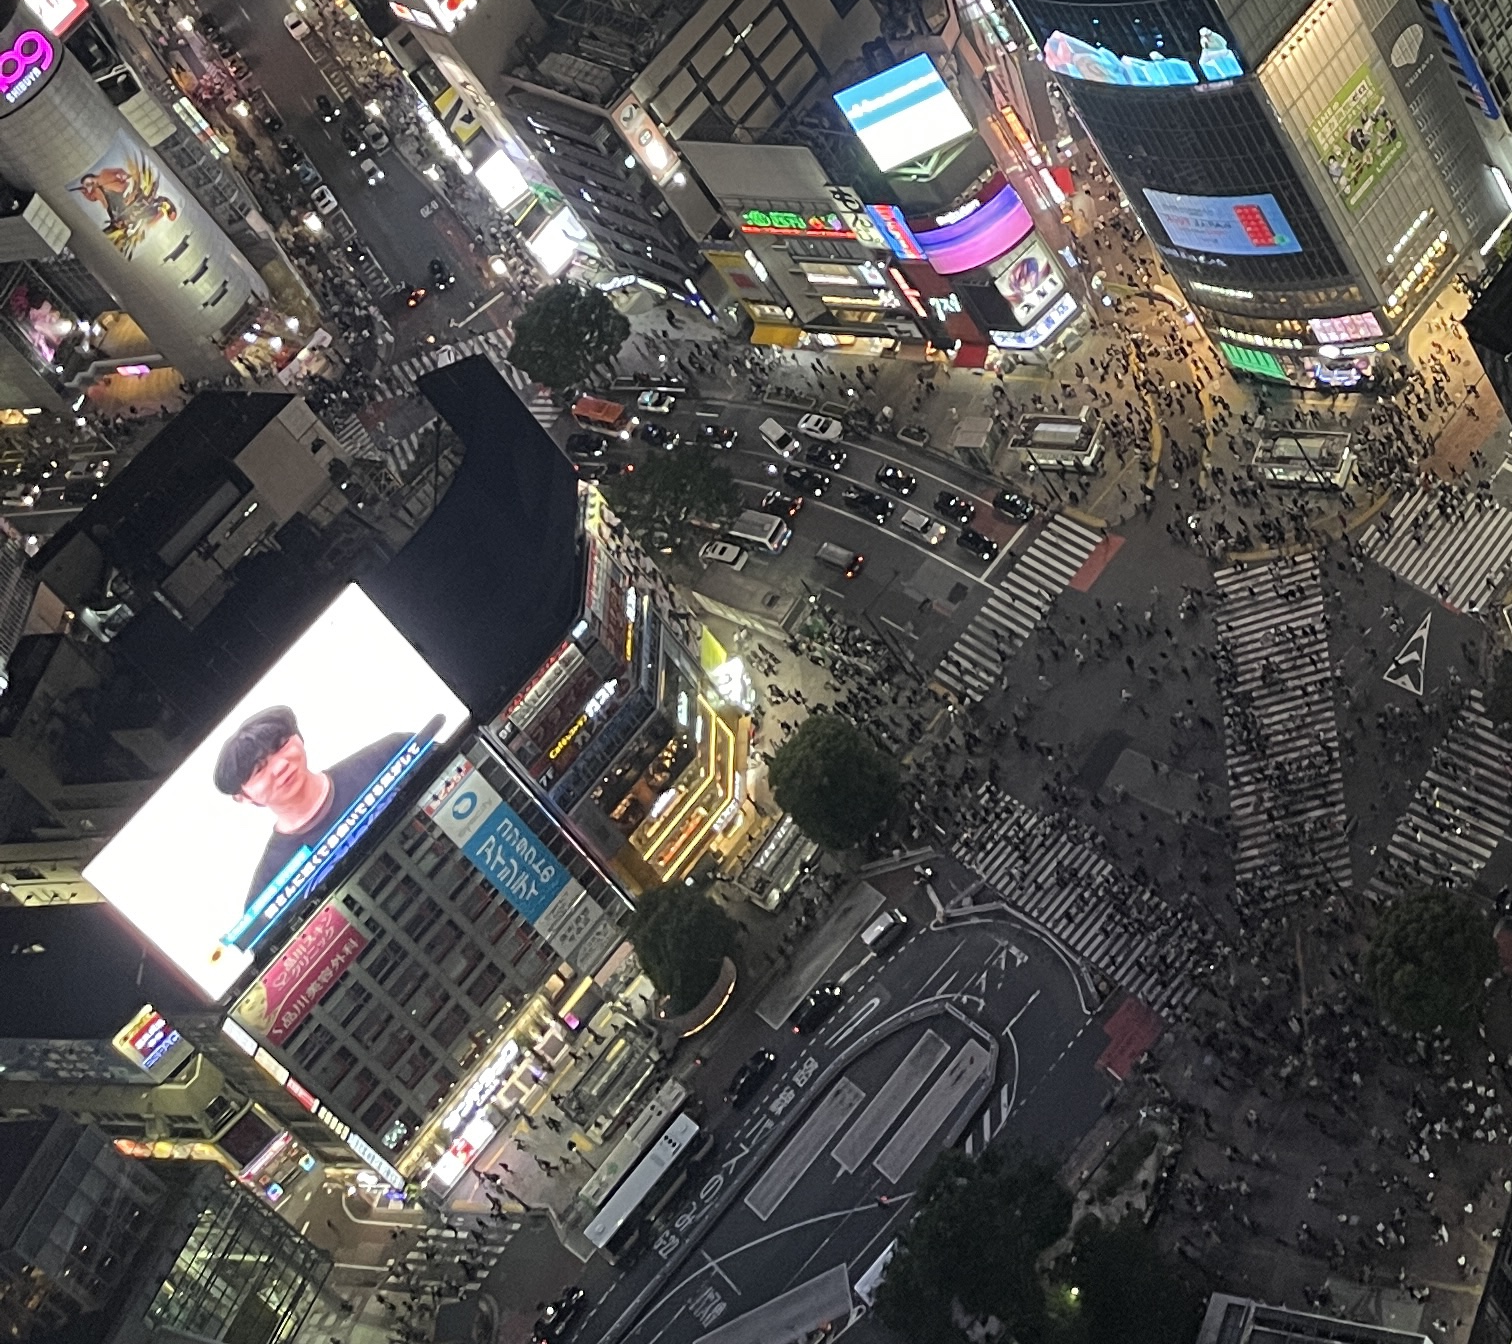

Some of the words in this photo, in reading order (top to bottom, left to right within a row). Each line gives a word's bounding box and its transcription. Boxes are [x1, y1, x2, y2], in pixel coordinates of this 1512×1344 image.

[0, 29, 54, 98] 09
[5, 67, 43, 104] SHIBUYA
[281, 937, 360, 1029] 品川美容外科
